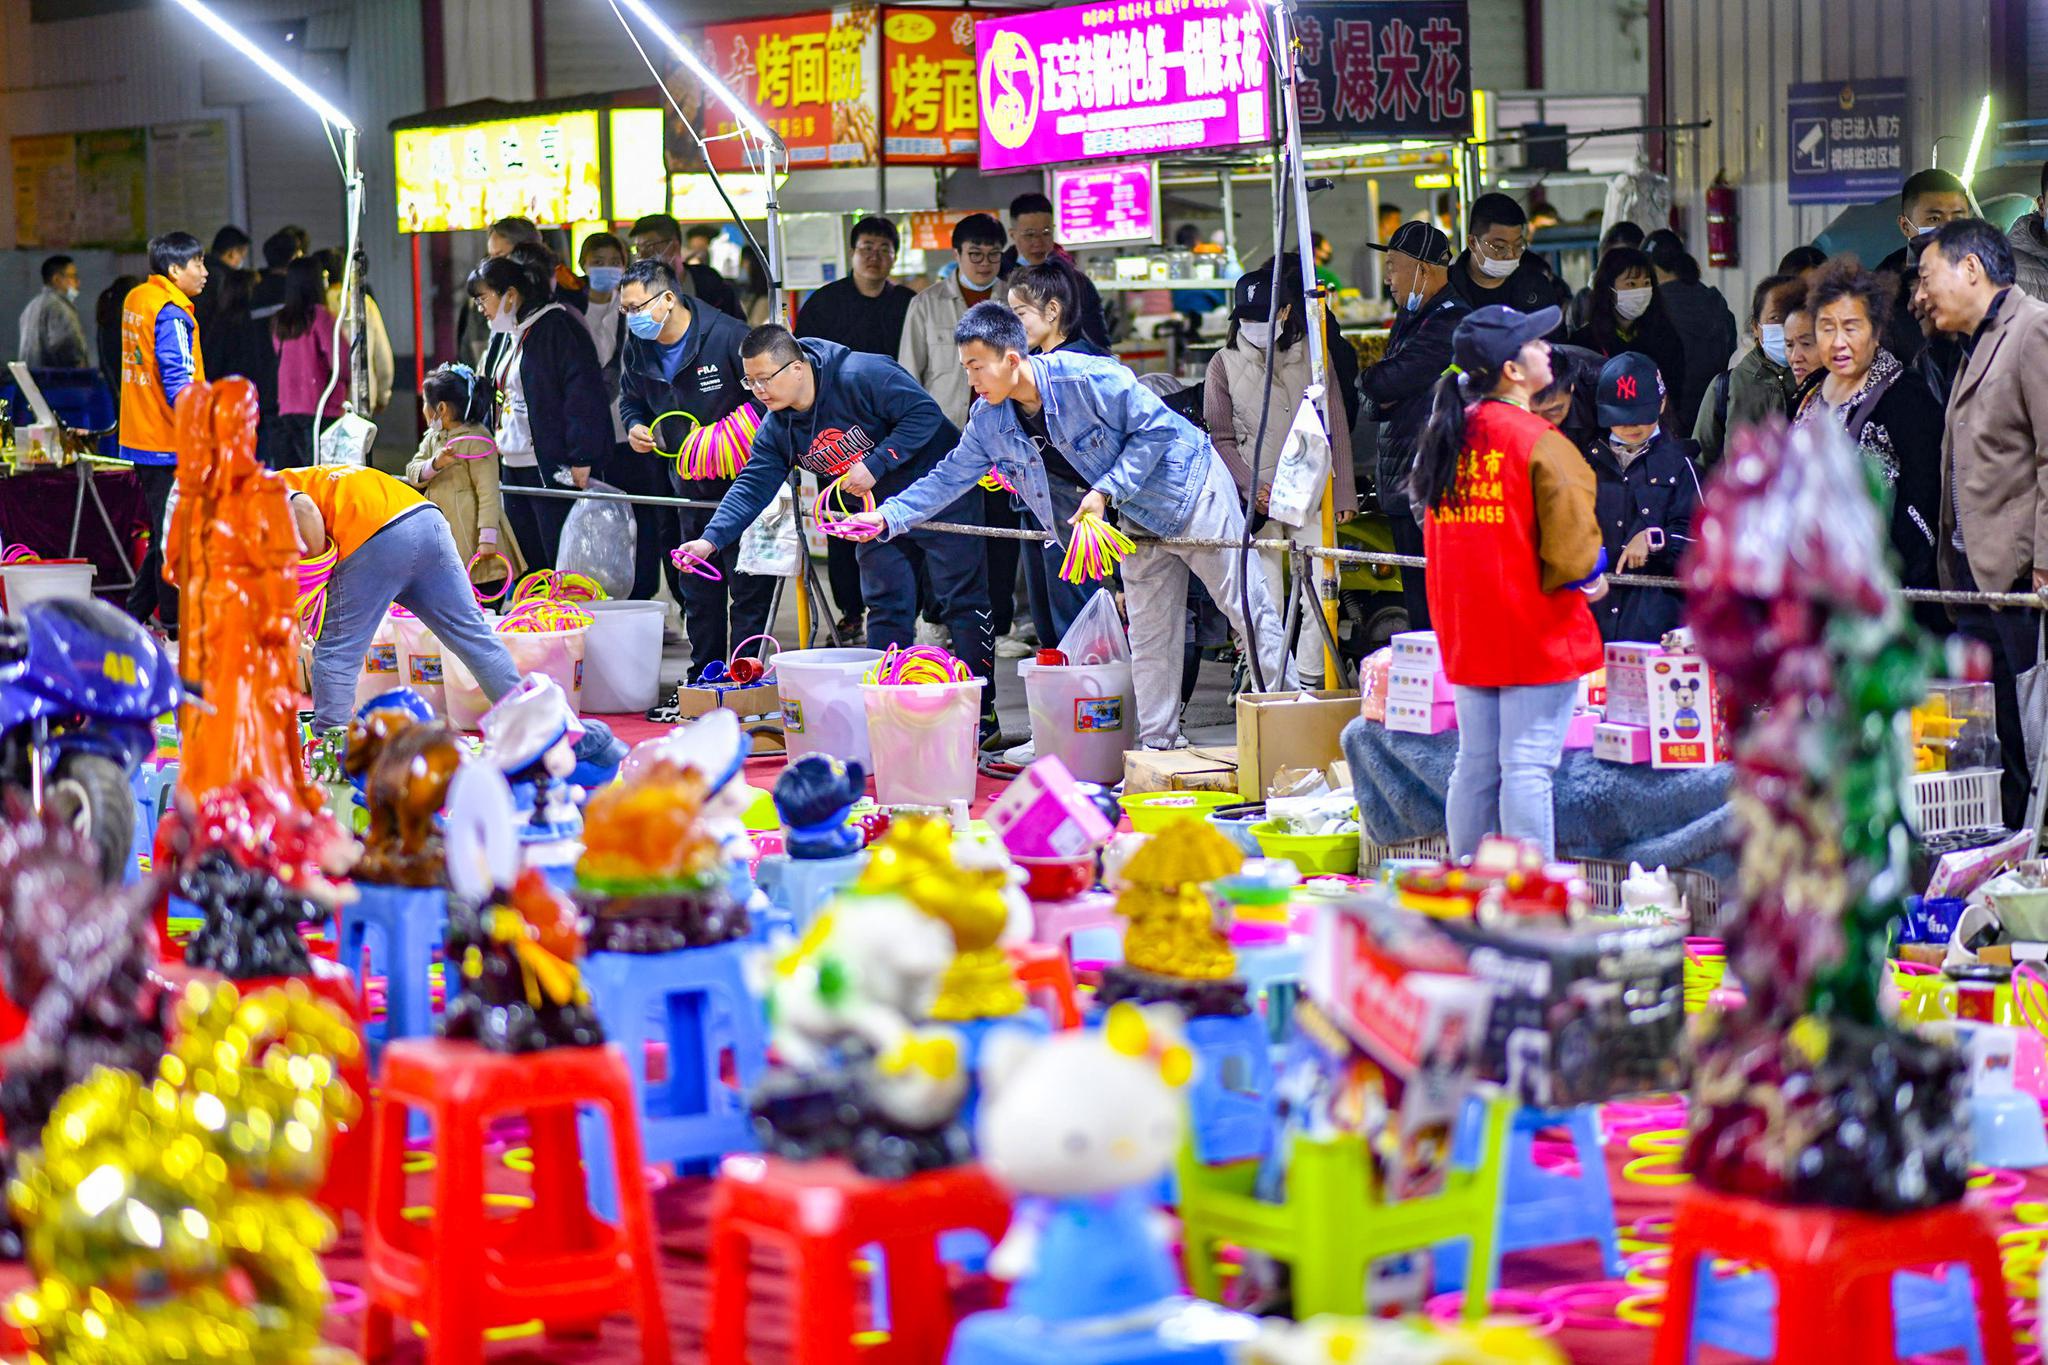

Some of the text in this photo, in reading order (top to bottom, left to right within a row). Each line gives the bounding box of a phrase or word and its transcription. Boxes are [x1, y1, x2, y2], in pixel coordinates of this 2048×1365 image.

[755, 27, 865, 108] 烤面筋
[1331, 17, 1465, 123] 爆米花
[1830, 115, 1901, 140] 您已进入警方
[1831, 145, 1901, 171] 视频监控区域
[697, 364, 719, 376] FILA
[1616, 374, 1637, 400] NY
[797, 424, 875, 474] PORTLAND
